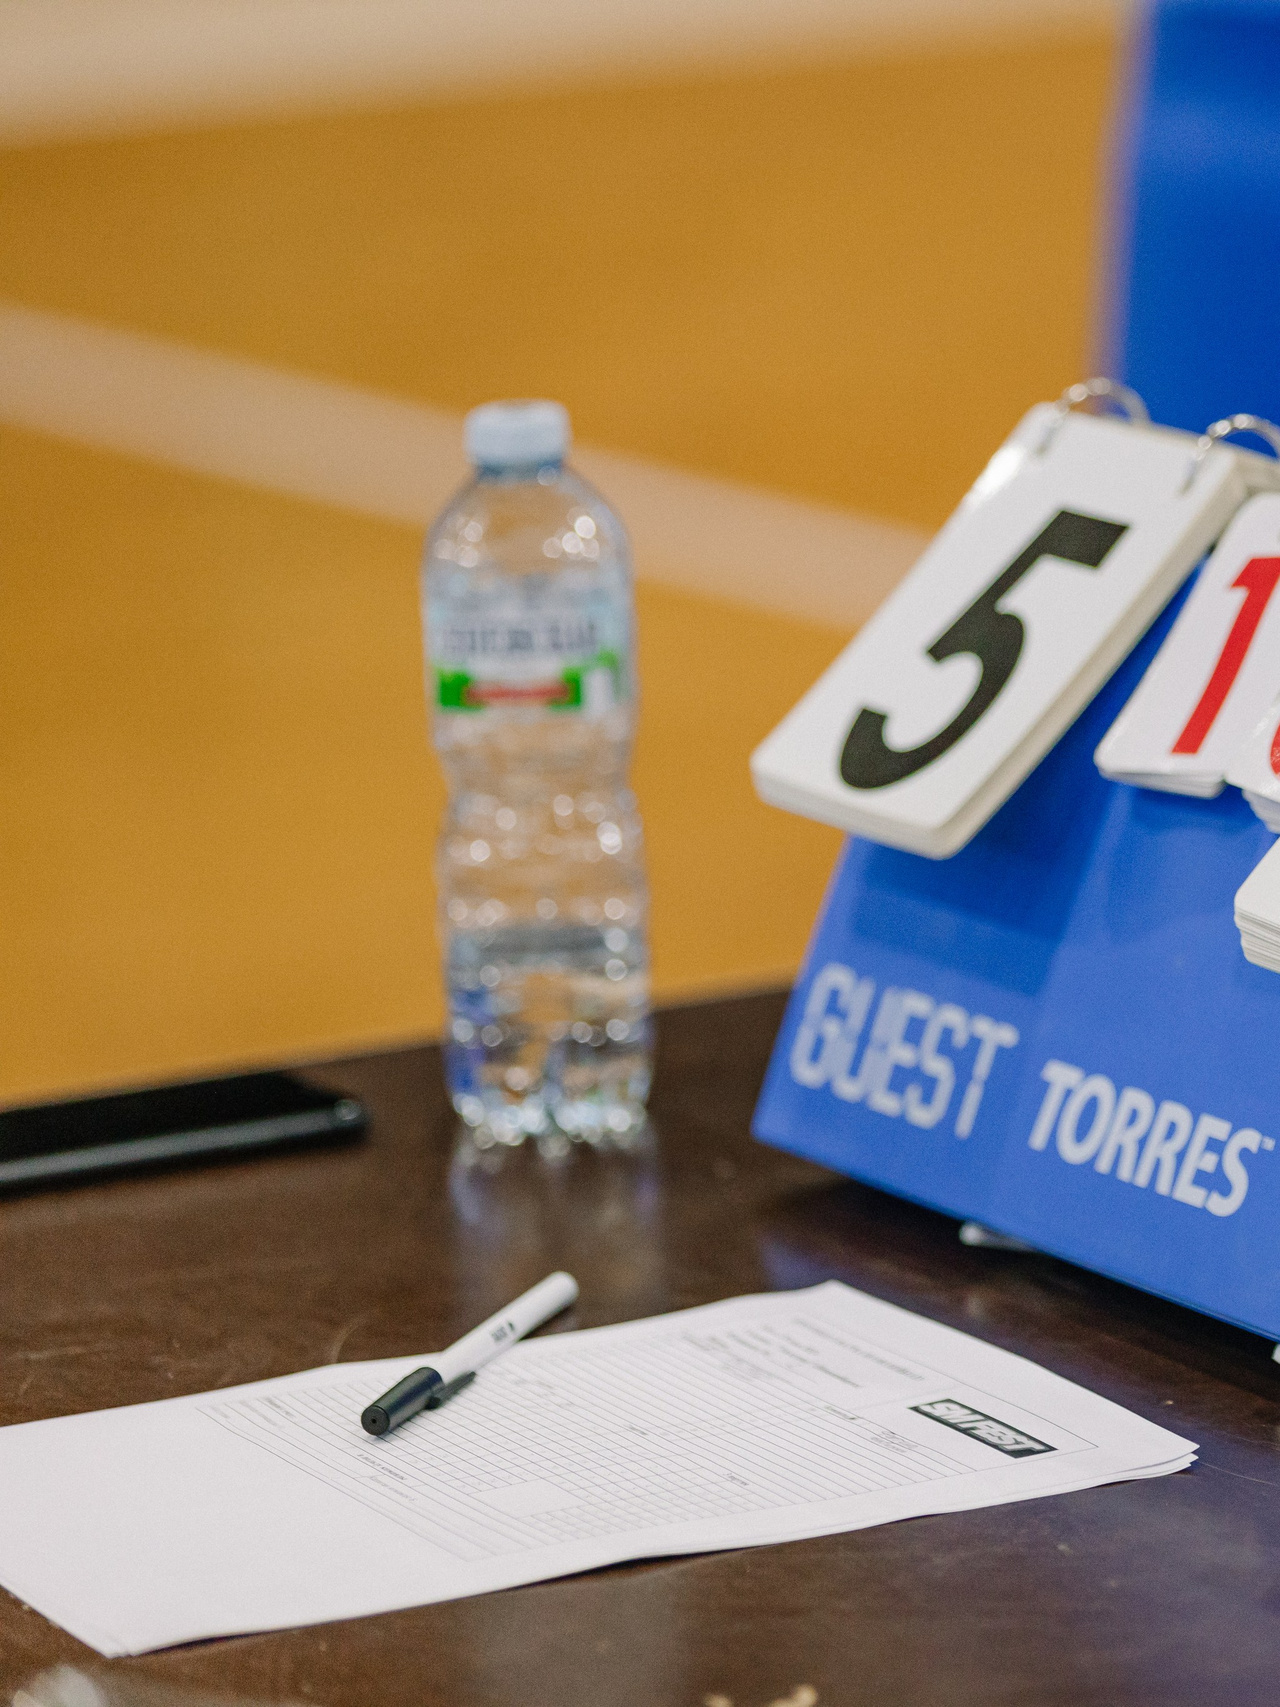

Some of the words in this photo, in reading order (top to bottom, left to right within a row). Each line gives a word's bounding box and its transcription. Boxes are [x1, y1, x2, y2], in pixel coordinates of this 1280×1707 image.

[839, 509, 1130, 790] 5
[791, 964, 1019, 1139] GUEST
[1029, 1060, 1264, 1217] TORRES
